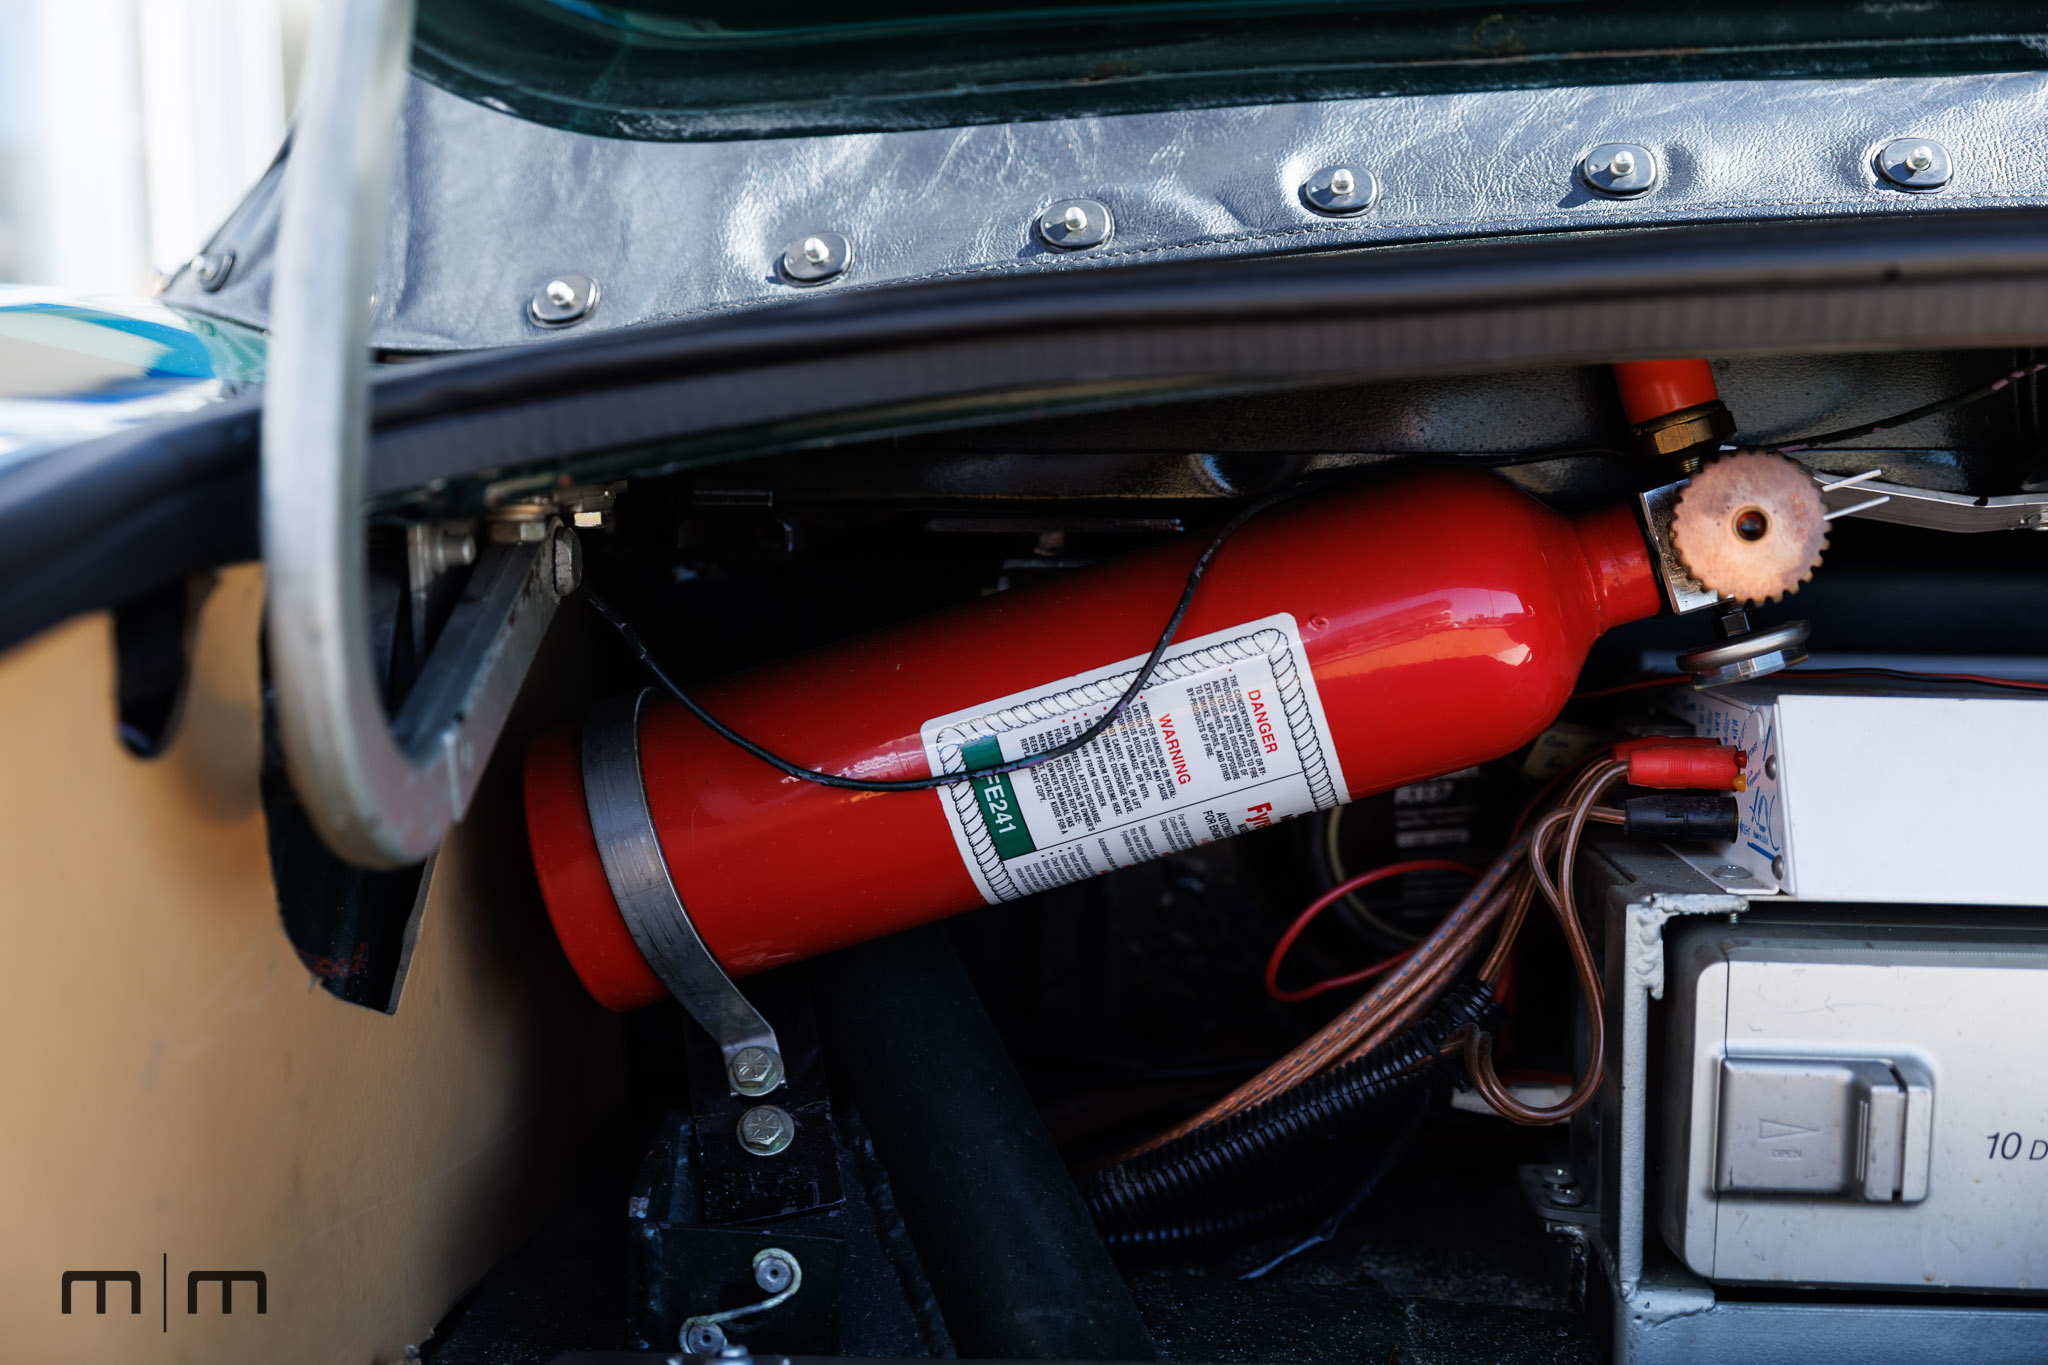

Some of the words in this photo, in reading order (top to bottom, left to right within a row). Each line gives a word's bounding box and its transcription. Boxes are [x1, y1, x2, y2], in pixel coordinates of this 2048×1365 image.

[1194, 684, 1203, 694] TO
[1228, 674, 1238, 688] THE
[1219, 677, 1237, 712] PRODUCTS
[1131, 703, 1144, 727] LATION
[1139, 701, 1156, 736] IMPROPER
[1185, 687, 1206, 732] BY-PRODUCTS
[1197, 695, 1211, 721] SMOKE,
[1232, 688, 1254, 738] CONCENTRATED
[1211, 679, 1221, 693] ARE
[1216, 694, 1228, 713] TOXIC
[1222, 714, 1234, 734] AFTER
[1229, 735, 1245, 768] DISCHARGE
[1240, 768, 1248, 777] OF
[1231, 713, 1243, 732] WHEN
[1246, 688, 1279, 754] DANGER
[1139, 728, 1147, 737] OF
[1200, 733, 1209, 742] OF
[1205, 721, 1220, 749] VAPORS,
[1110, 738, 1124, 762] CARRY,
[1122, 706, 1137, 735] SERIOUS
[1132, 736, 1145, 758] BODILY
[1139, 759, 1153, 782] INJURY,
[1142, 738, 1152, 753] THIS
[1150, 736, 1167, 768] HANDLING
[1157, 713, 1192, 785] WARNING
[1203, 743, 1214, 759] FIRE.
[1237, 733, 1251, 758] APPLIED
[1248, 738, 1260, 757] AGENT
[1053, 759, 1064, 772] FOR
[1124, 744, 1140, 773] DAMAGE,
[1147, 753, 1157, 768] UNIT
[1214, 749, 1224, 762] AND
[1218, 732, 1230, 751] AVOID
[1224, 751, 1240, 780] EXPOSURE
[1245, 758, 1254, 766] TO
[1255, 757, 1263, 766] OR
[1027, 735, 1039, 753] BEEN
[1040, 772, 1055, 800] CONTACT
[1050, 800, 1062, 818] KIDDE
[1056, 818, 1066, 829] FOR
[1061, 725, 1071, 736] DO
[1069, 751, 1082, 772] REFILL
[1077, 772, 1089, 792] AFTER
[1084, 792, 1101, 825] DISCHARGE.
[1062, 755, 1083, 800] INSTRUCTIONS
[1118, 762, 1133, 788] HANDLE,
[1135, 773, 1143, 782] OR
[1152, 769, 1162, 782] MAY
[1161, 768, 1170, 778] OR
[1219, 762, 1231, 781] OTHER
[1248, 766, 1258, 779] FIRE
[1258, 766, 1266, 776] BY-
[1034, 784, 1046, 803] COPY.
[1058, 772, 1073, 798] PROPER
[1084, 759, 1096, 777] FROM
[1091, 777, 1107, 808] CHILDREN.
[1095, 755, 1107, 774] FROM
[1102, 774, 1117, 802] EXTREME
[1111, 801, 1122, 816] HEAT.
[1110, 762, 1127, 796] DISCHARGE
[1121, 796, 1133, 814] VALVE.
[1128, 788, 1137, 797] OR
[1138, 782, 1149, 800] BOTH.
[1157, 782, 1169, 801] CAUSE
[1164, 778, 1177, 799] INSTAL-
[1045, 762, 1061, 791] OWNER'S
[1056, 791, 1070, 816] MANUAL
[1065, 816, 1074, 828] HAS
[1078, 800, 1086, 808] IN
[1131, 797, 1141, 810] LIFT
[1067, 797, 1082, 825] REPLACE-
[1080, 807, 1095, 832] OWNER'S
[1202, 809, 1216, 825] FOR
[1772, 1149, 1802, 1160] OPEN
[1987, 1131, 2022, 1161] 10
